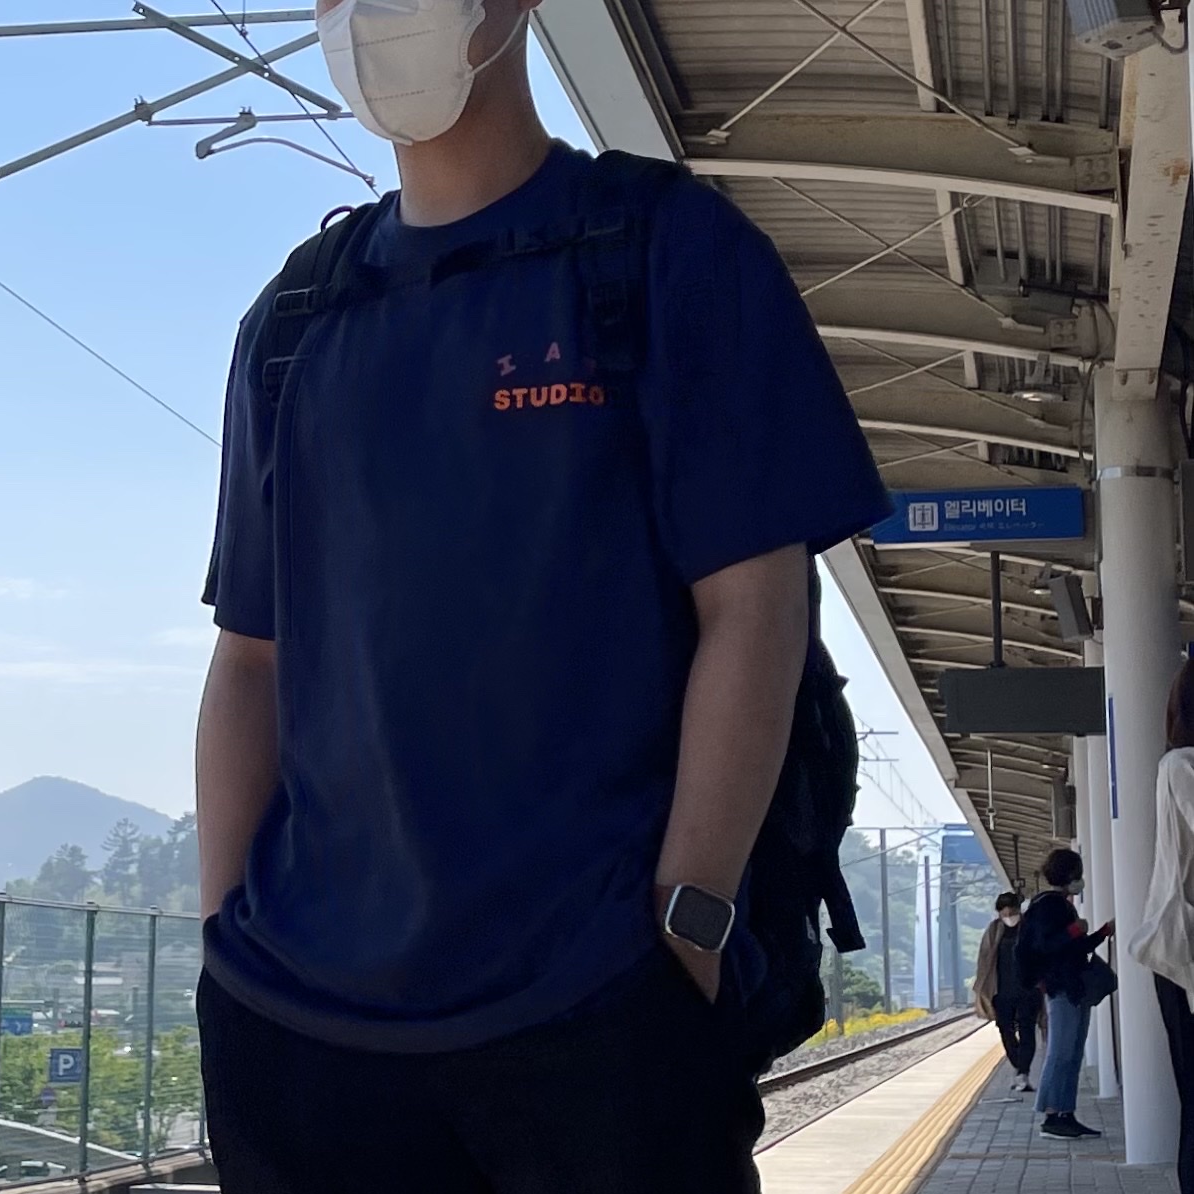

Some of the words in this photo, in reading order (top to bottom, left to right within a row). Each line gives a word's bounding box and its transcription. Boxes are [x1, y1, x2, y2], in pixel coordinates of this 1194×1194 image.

[494, 383, 605, 410] STUDIO
[944, 498, 1026, 518] 엘리베이터
[58, 1054, 75, 1076] P
